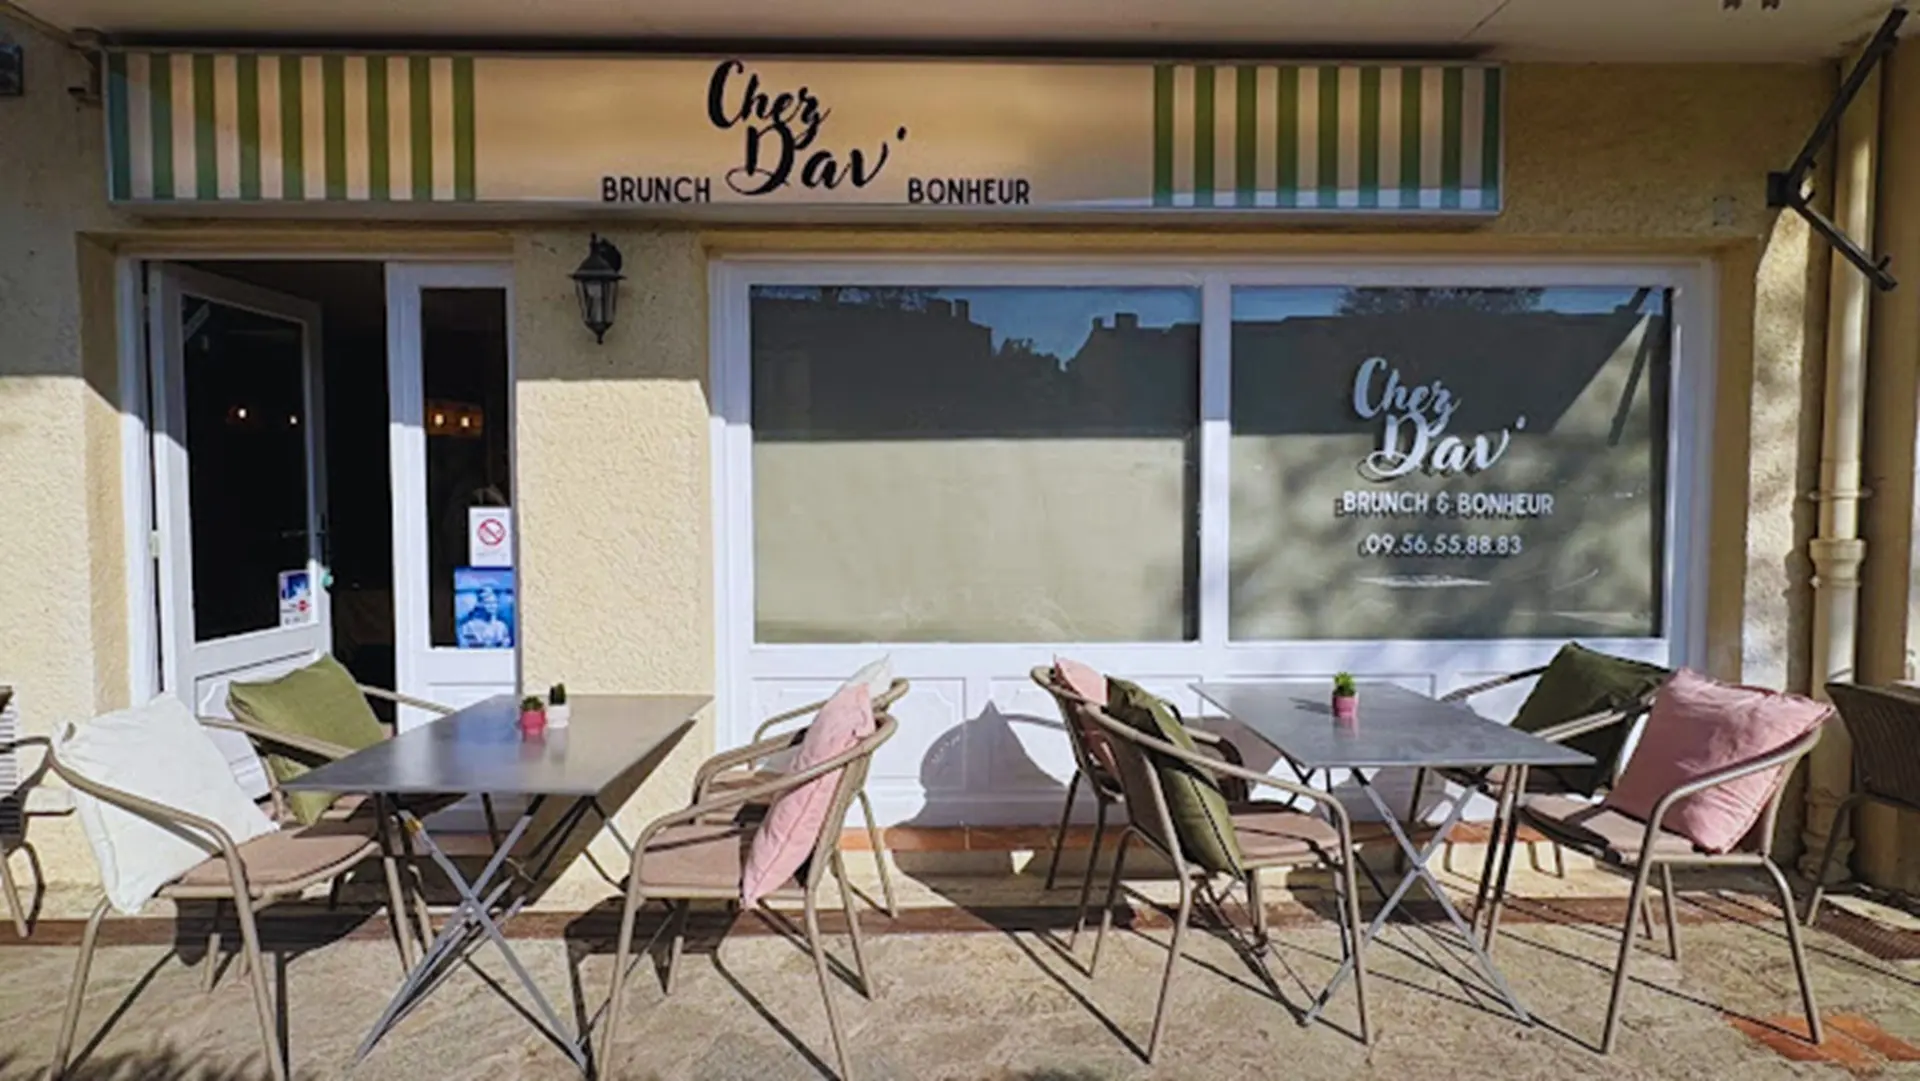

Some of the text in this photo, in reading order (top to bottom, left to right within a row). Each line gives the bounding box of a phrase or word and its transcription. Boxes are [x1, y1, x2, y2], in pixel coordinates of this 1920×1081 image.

[707, 59, 831, 149] Chez
[601, 176, 711, 203] BRUNCH
[907, 177, 1031, 205] BONHEUR
[1353, 356, 1462, 437] Chez
[1342, 490, 1555, 515] BRUNCH & BONHEUR
[1365, 533, 1523, 555] 09.56.55.88.83
